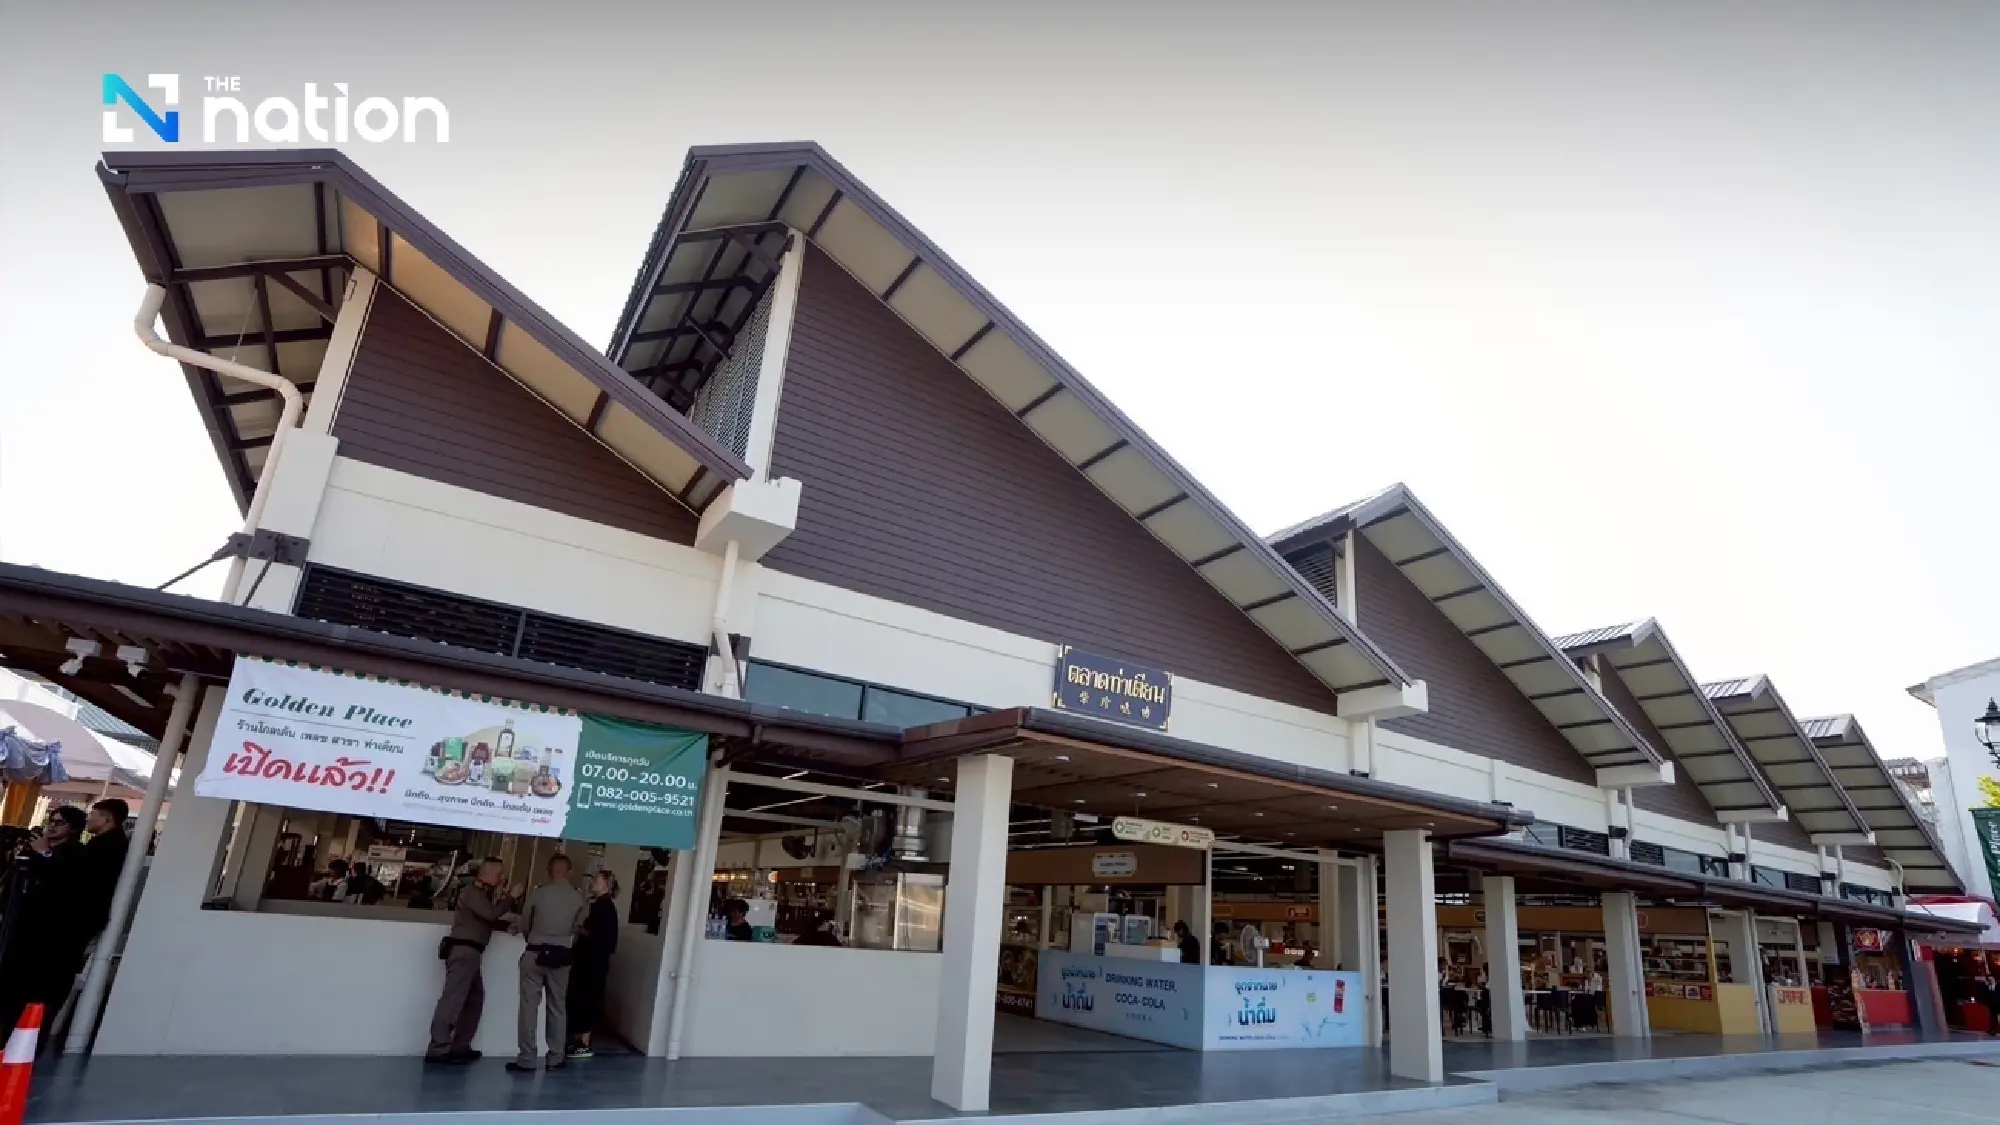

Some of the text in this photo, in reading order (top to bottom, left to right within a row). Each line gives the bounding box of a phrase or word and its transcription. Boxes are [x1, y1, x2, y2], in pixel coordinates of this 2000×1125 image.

[1068, 664, 1165, 704] ตลาดท่าเตียน
[242, 687, 413, 729] Golden Place
[223, 740, 396, 794] เปิดแล้ว!!
[593, 800, 693, 816] www.goldenplace.co.th
[596, 785, 695, 807] 082-005-9521
[1105, 972, 1144, 988] DRINKING
[1237, 996, 1276, 1026] น้ำดื่ม
